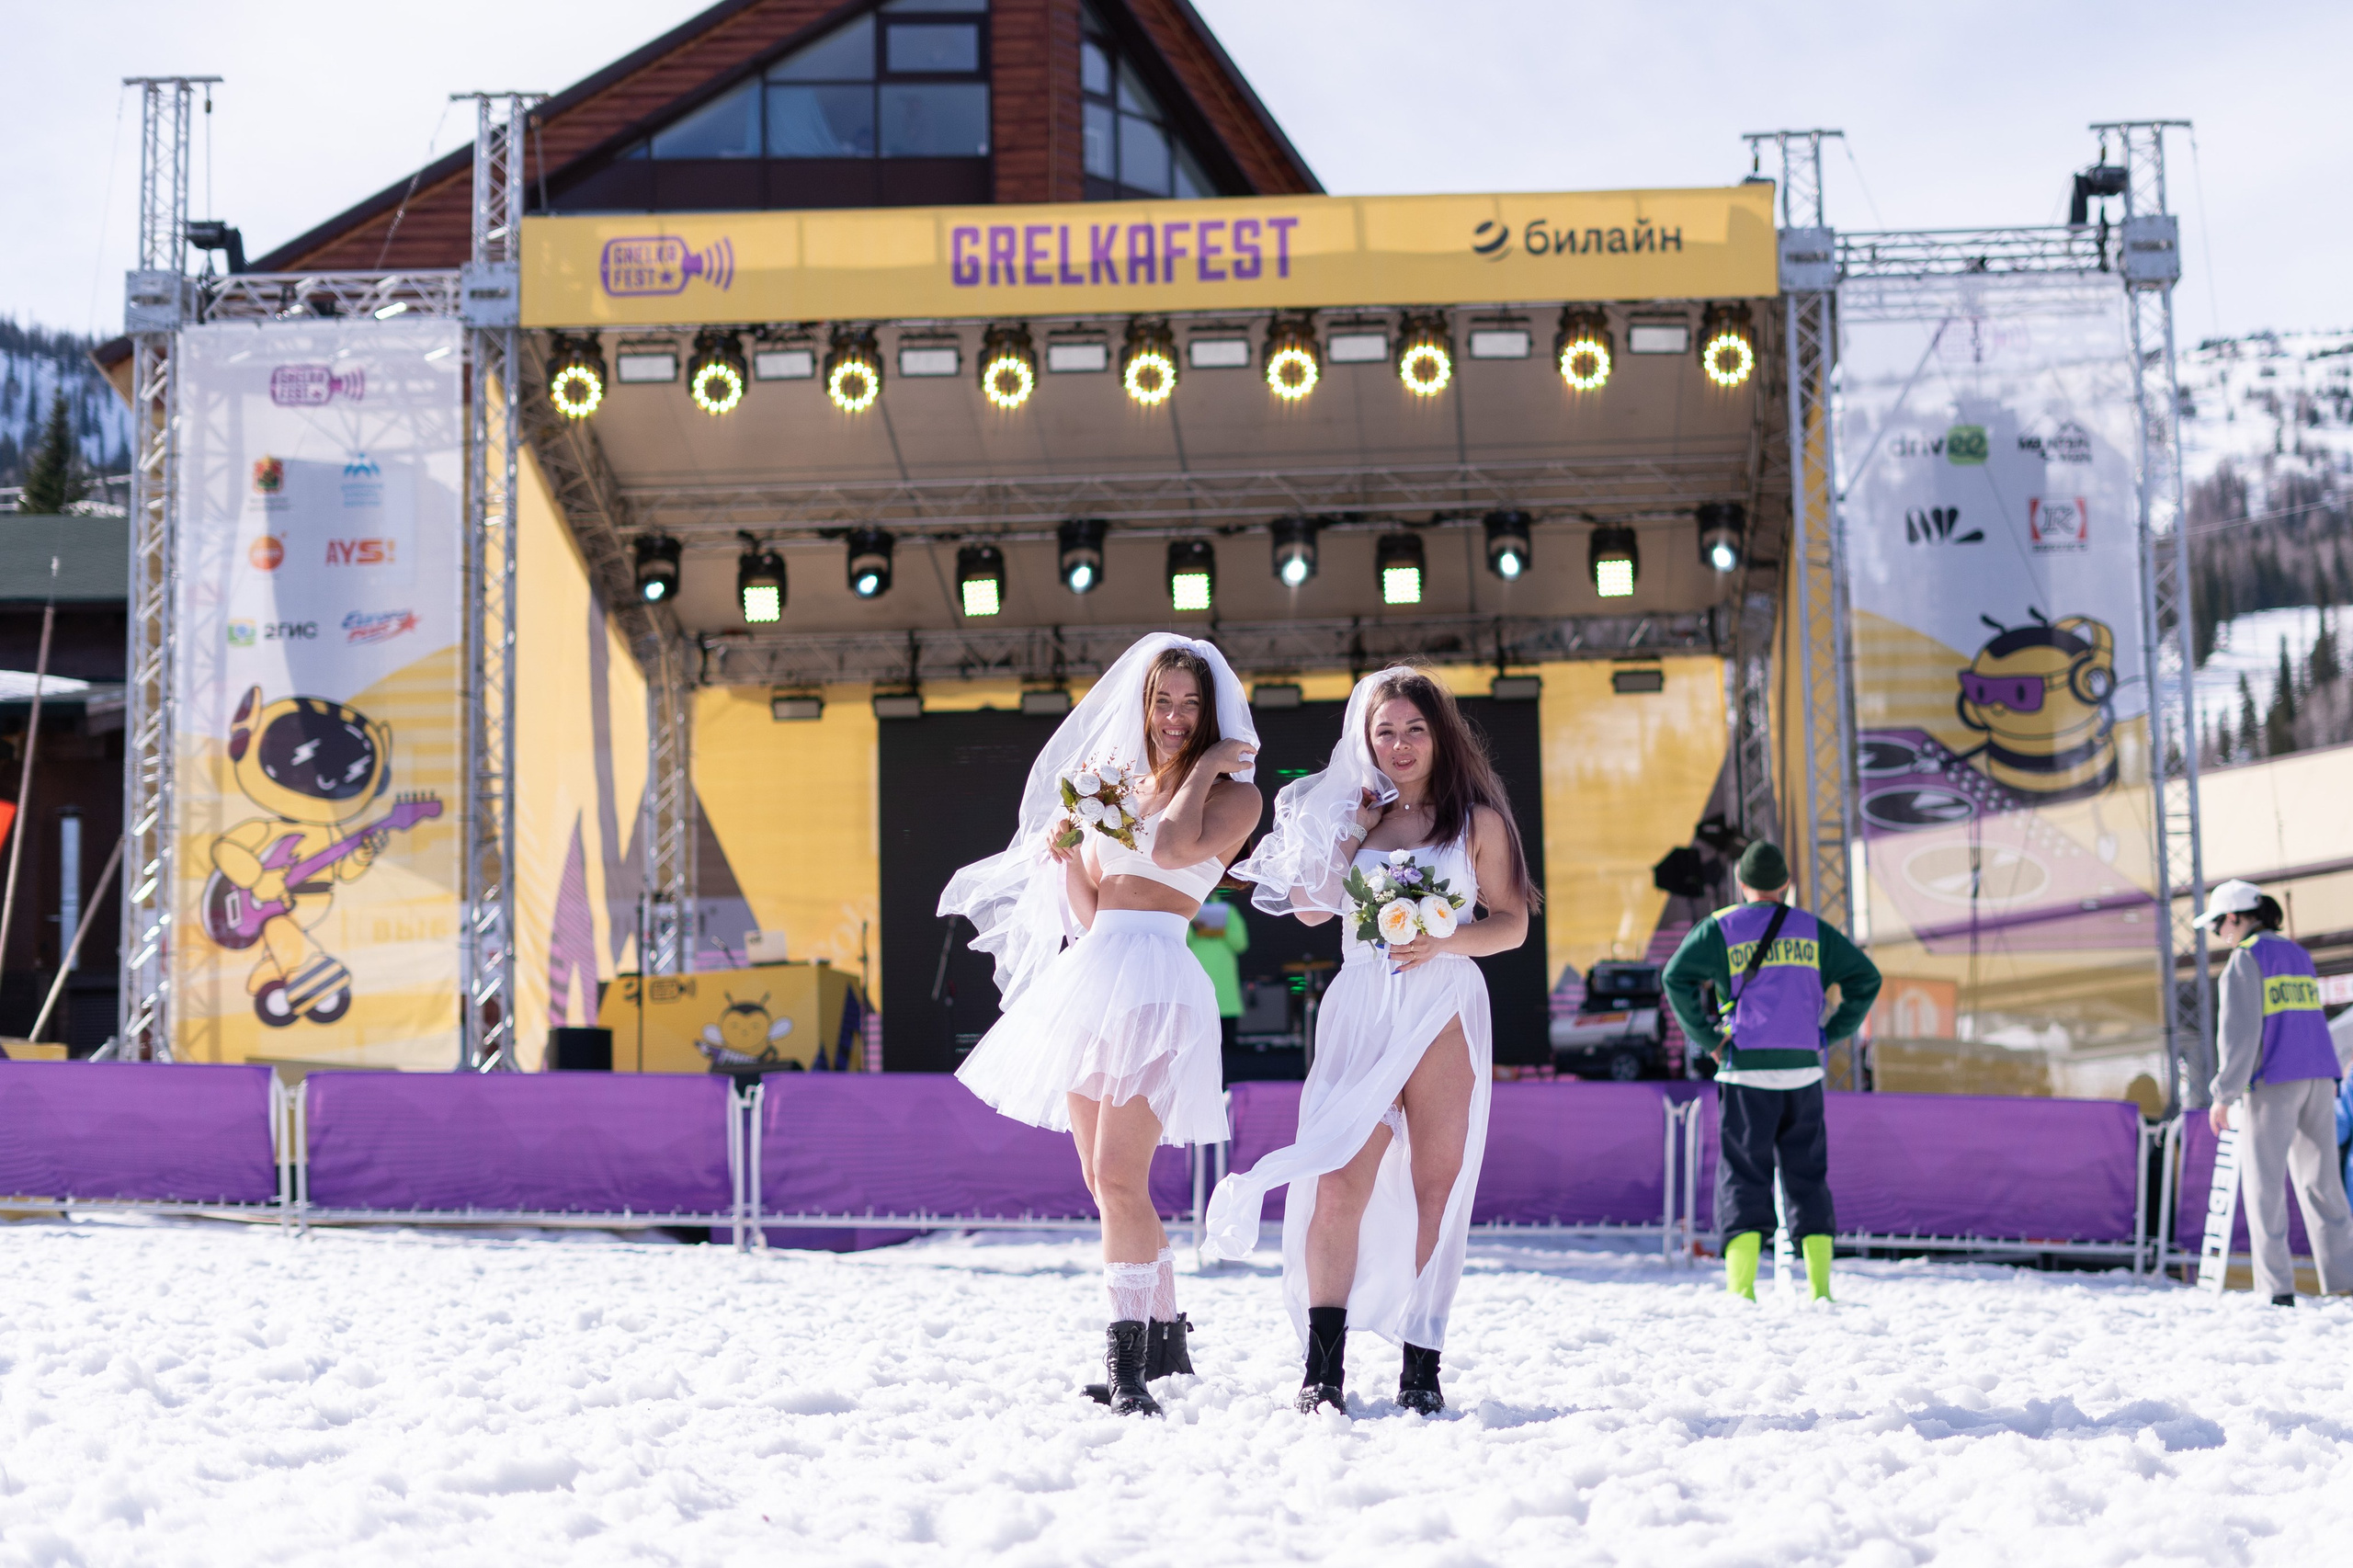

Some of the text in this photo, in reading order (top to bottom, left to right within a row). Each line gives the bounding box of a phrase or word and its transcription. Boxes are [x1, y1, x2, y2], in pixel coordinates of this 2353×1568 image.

[952, 216, 1300, 287] GRELKAFEST
[1524, 219, 1684, 257] билайн
[614, 267, 655, 288] FEST
[264, 621, 318, 640] 2ГИС
[1730, 939, 1814, 967] ФООГРАФ
